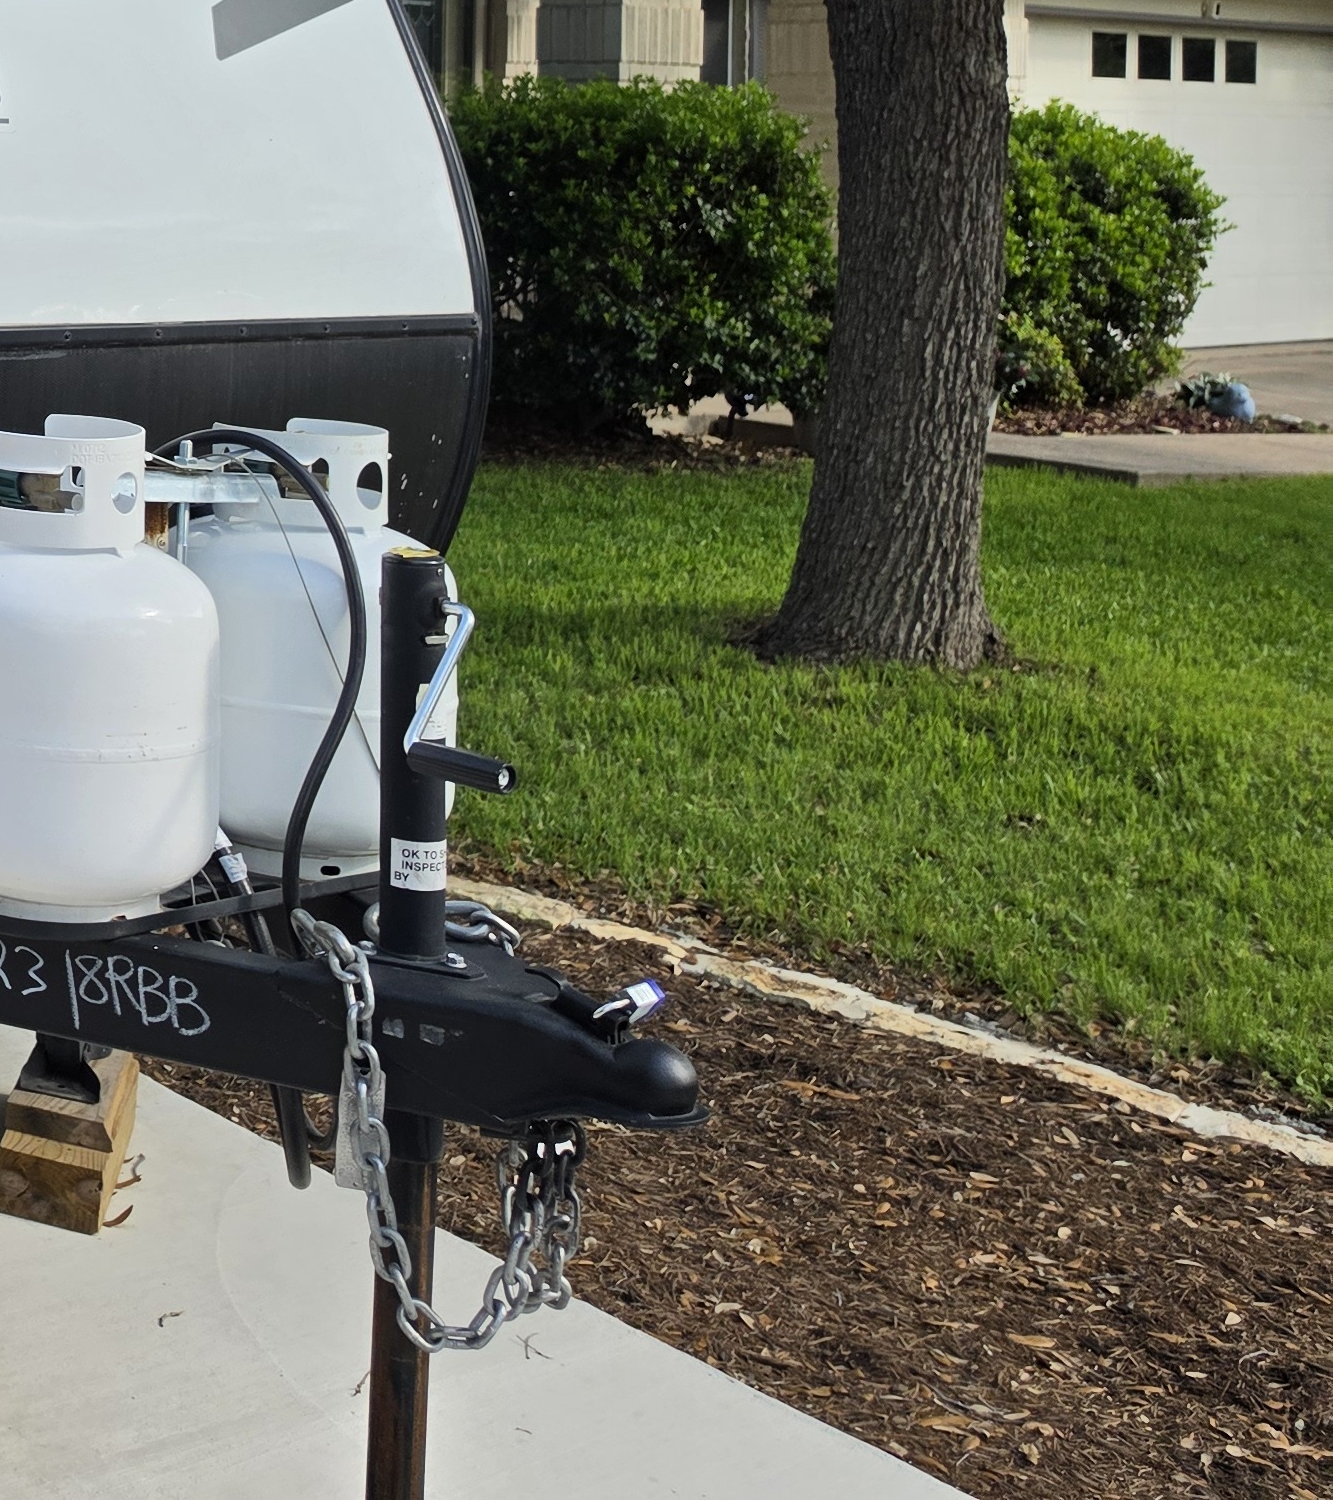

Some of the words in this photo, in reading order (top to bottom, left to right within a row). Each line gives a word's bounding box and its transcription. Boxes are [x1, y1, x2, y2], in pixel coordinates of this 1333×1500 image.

[401, 848, 420, 860] OK
[423, 850, 438, 860] TO
[394, 871, 410, 882] BY
[64, 948, 211, 1036] 18RBB
